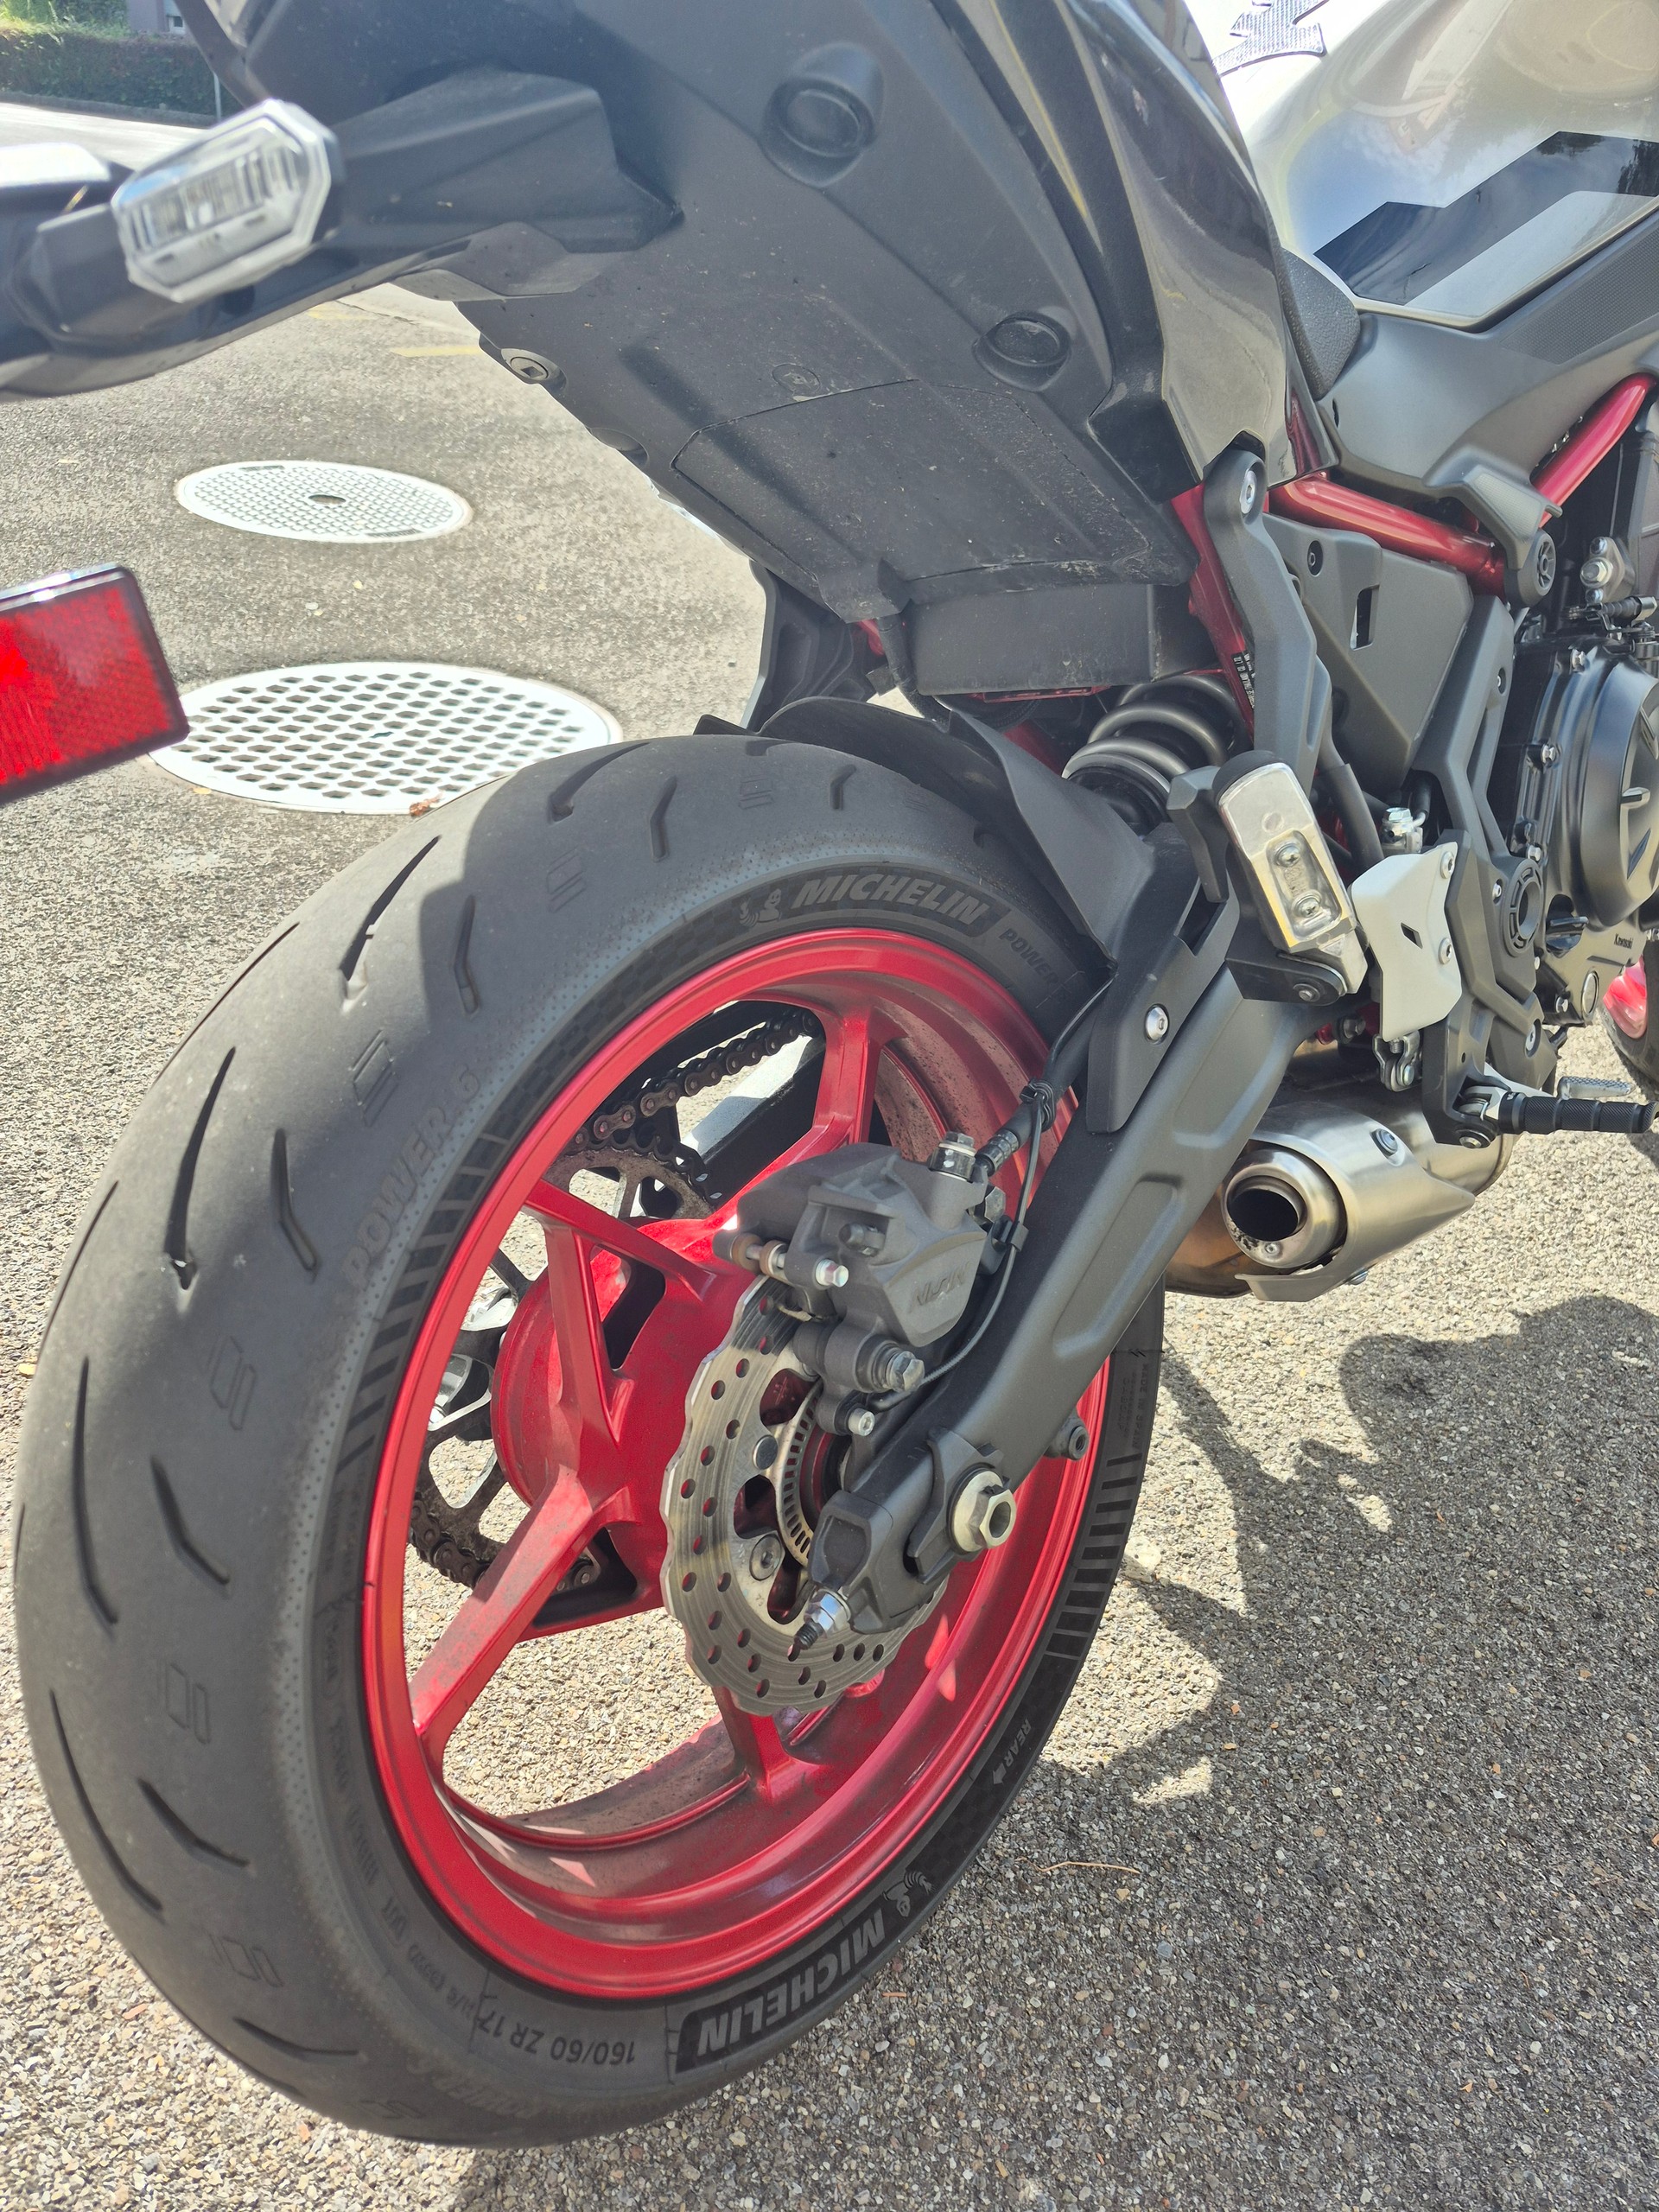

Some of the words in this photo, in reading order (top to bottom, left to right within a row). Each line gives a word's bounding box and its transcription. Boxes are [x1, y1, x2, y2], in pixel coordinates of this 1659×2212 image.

[791, 874, 990, 925] MICHELIN
[999, 927, 1059, 987] POWER
[340, 1106, 456, 1294] POWER
[1004, 1719, 1032, 1768] REAR
[697, 1908, 886, 2056] MICHELIN
[476, 2011, 505, 2037] 17
[510, 2024, 545, 2054] ZR
[550, 2036, 635, 2065] 160/60
